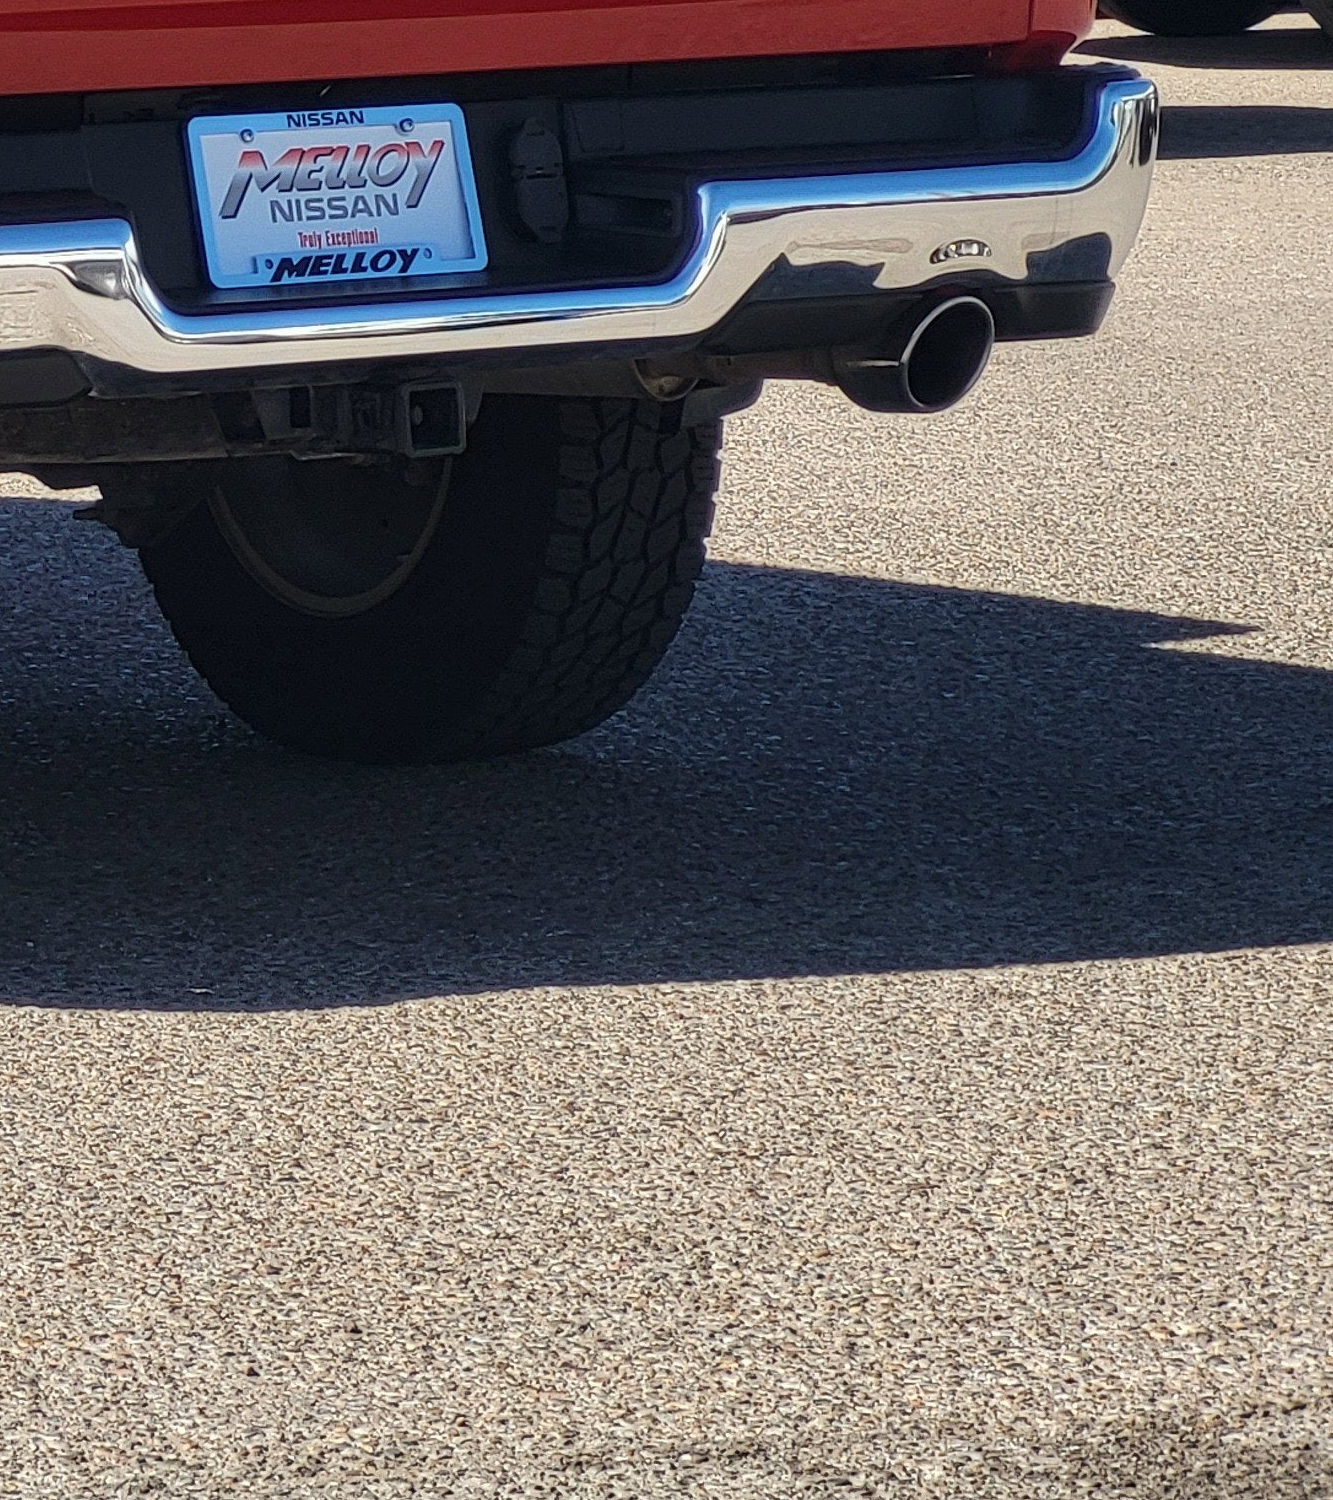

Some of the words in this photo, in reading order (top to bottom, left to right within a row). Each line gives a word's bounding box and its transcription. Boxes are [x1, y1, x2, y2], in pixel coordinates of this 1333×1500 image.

[286, 110, 365, 129] NISSAN
[219, 139, 445, 219] MELLOY
[270, 193, 400, 223] NISSAN
[298, 231, 322, 250] Truly
[325, 227, 379, 247] Exceptional
[269, 247, 422, 283] MELLOY
